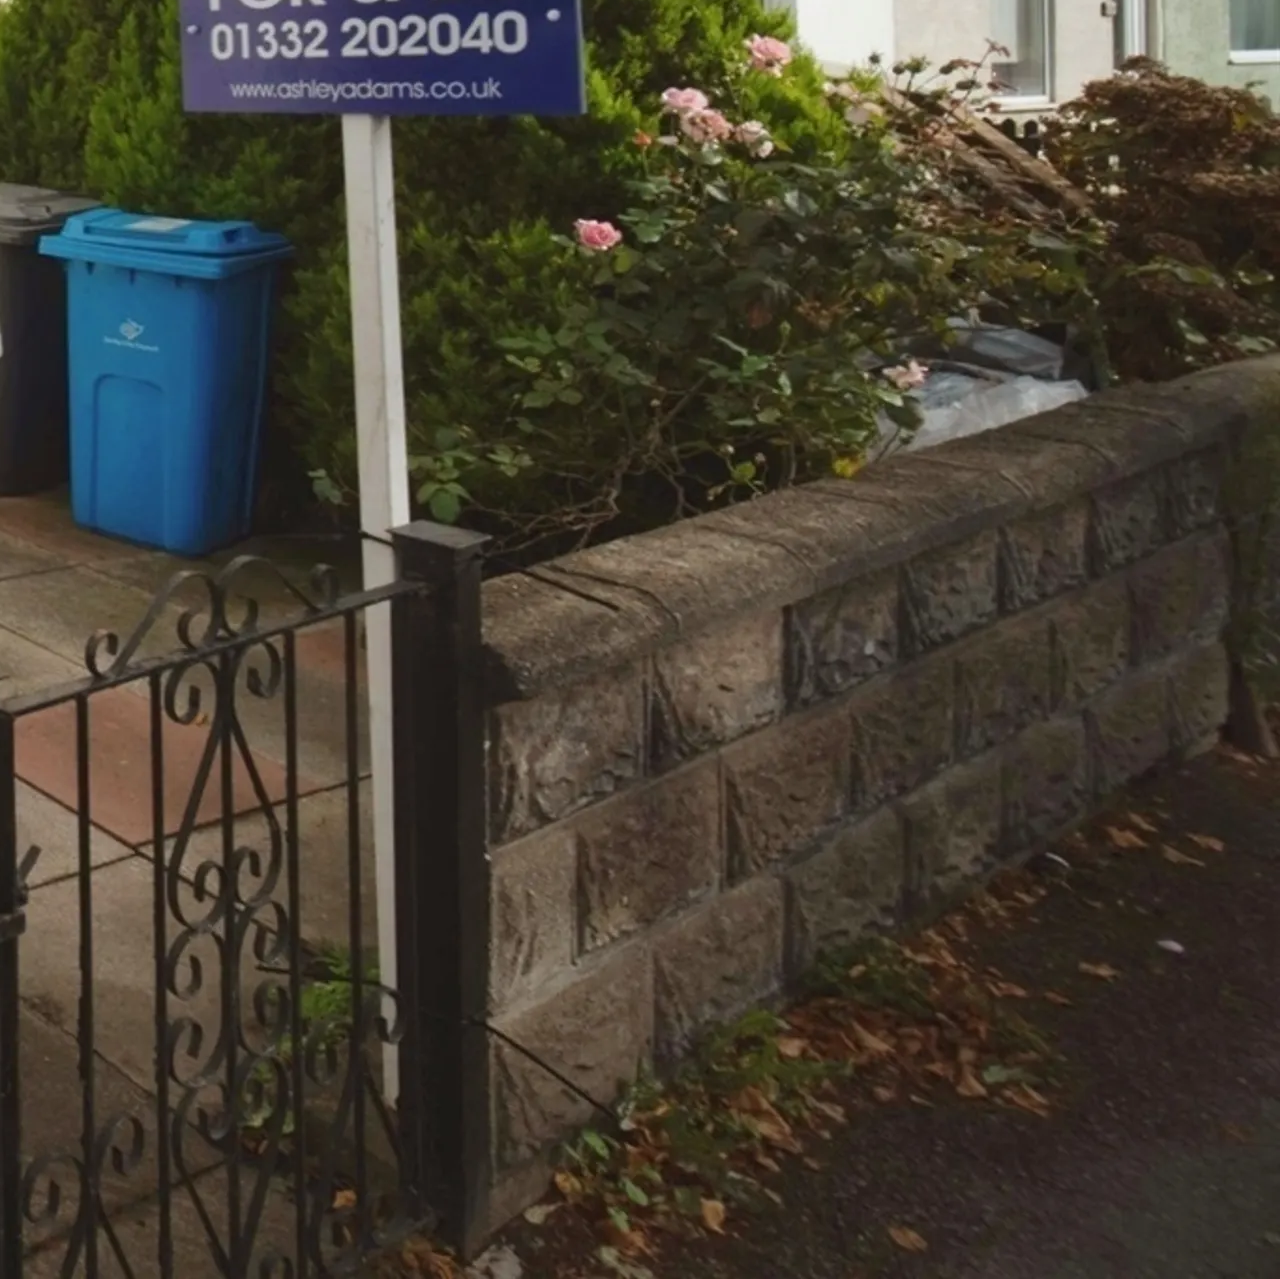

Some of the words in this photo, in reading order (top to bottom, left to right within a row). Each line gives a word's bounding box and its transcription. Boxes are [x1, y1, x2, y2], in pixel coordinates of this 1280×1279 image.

[209, 21, 330, 61] 01332
[340, 10, 529, 58] 202040
[229, 76, 503, 103] www.ashleyadams.co.uk
